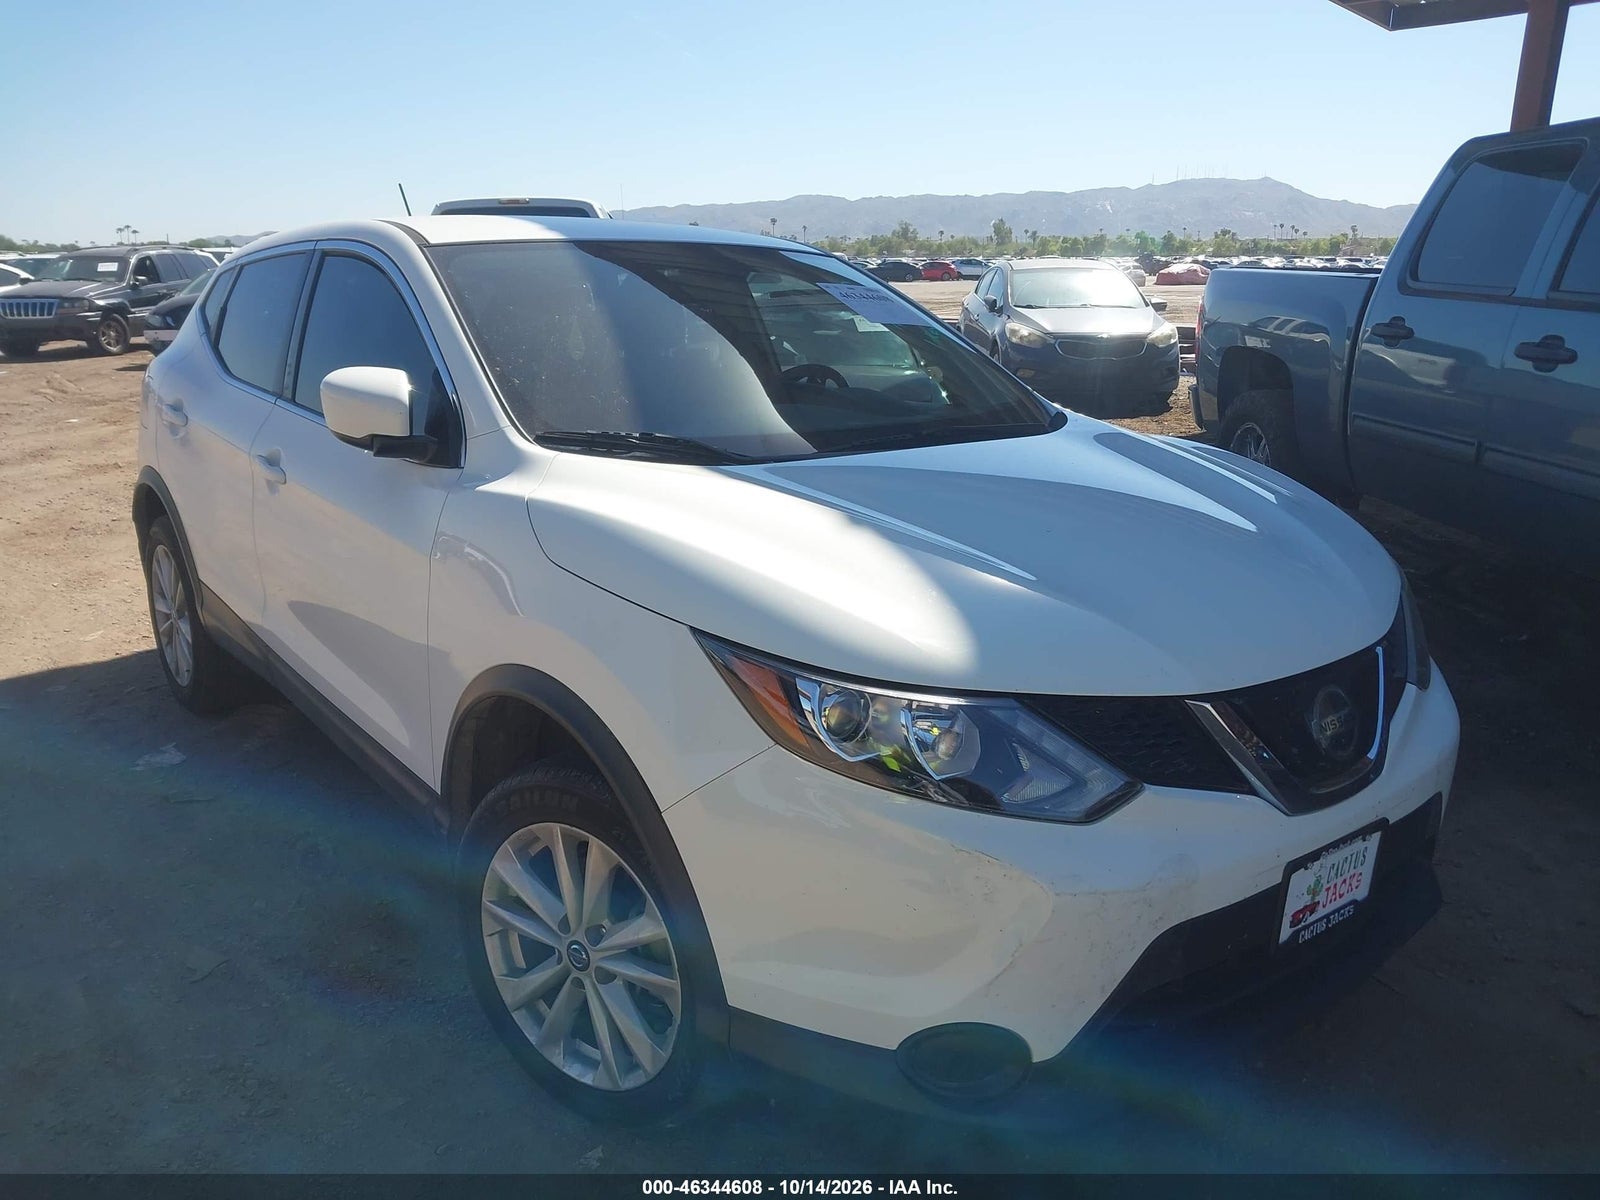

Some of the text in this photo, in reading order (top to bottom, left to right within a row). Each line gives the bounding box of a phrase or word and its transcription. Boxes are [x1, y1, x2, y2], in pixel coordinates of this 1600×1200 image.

[1327, 846, 1368, 883] CACTUS
[1322, 871, 1363, 908] JACKS
[1298, 905, 1355, 943] CACTUS JACKS
